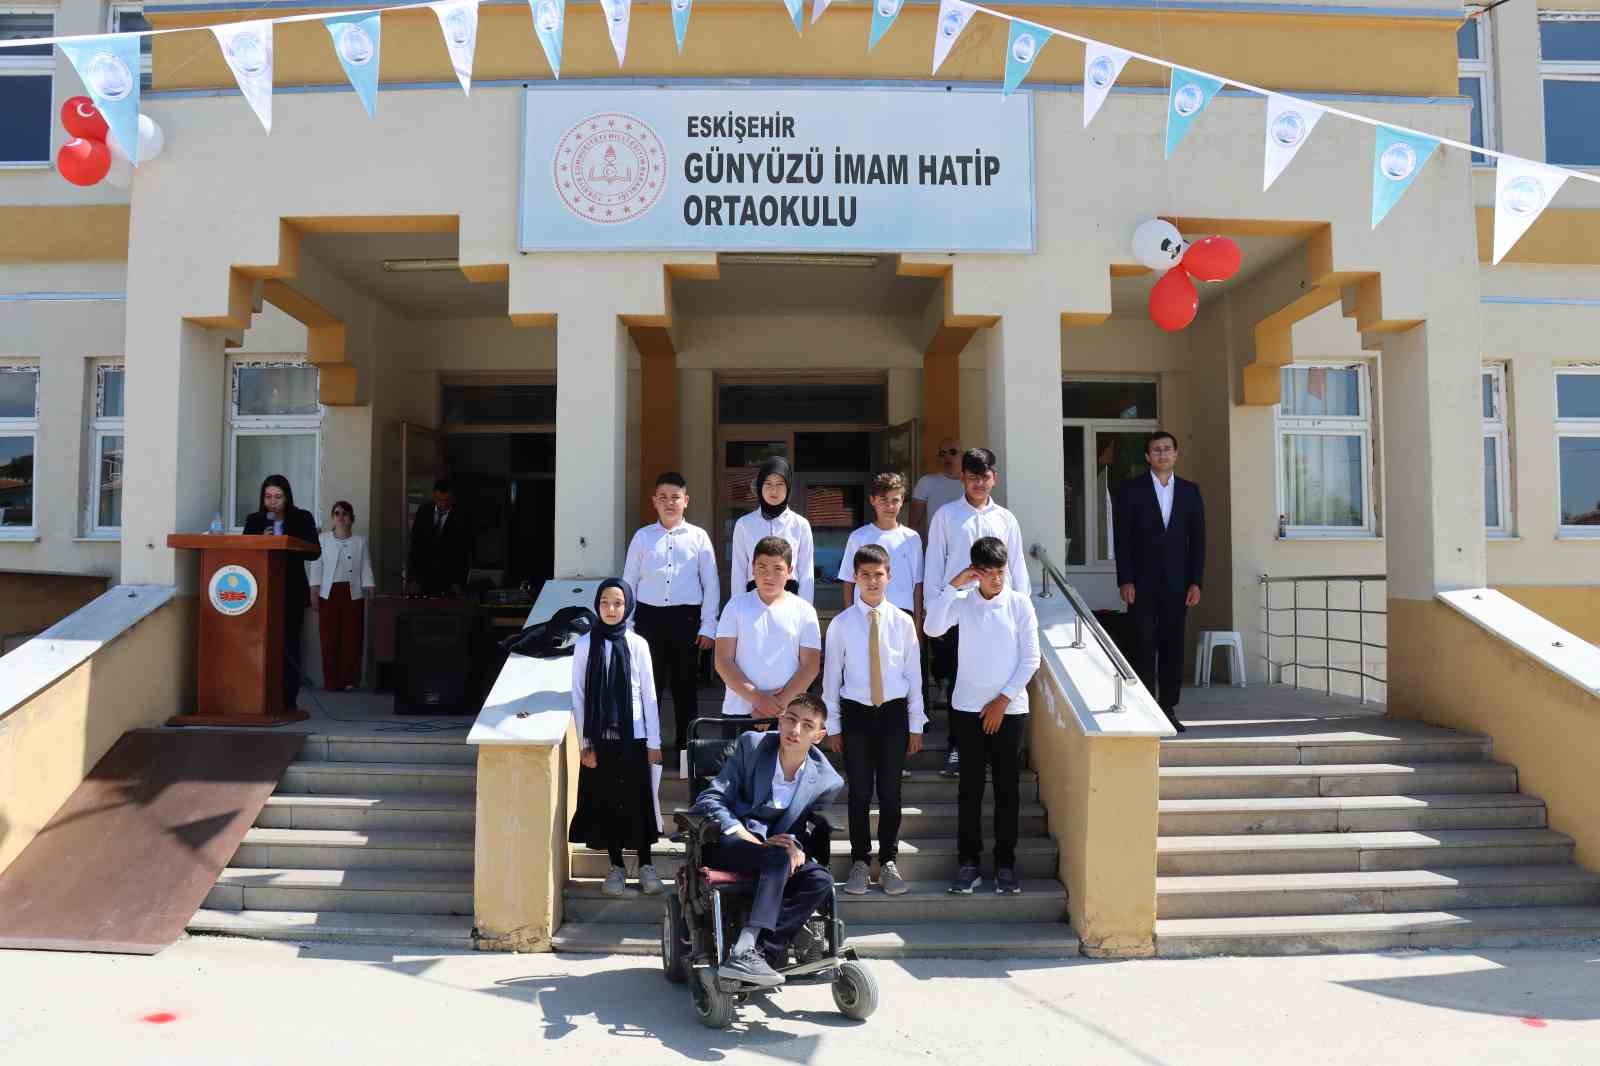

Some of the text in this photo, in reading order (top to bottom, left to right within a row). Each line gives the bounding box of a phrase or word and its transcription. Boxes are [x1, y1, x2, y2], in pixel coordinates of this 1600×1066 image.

[687, 111, 796, 144] ESKİŞEHİR
[684, 146, 824, 184] GÜNYÜZÜ
[834, 146, 909, 185] İMAM
[918, 148, 1000, 186] HATİP
[683, 194, 857, 227] ORTAOKULU
